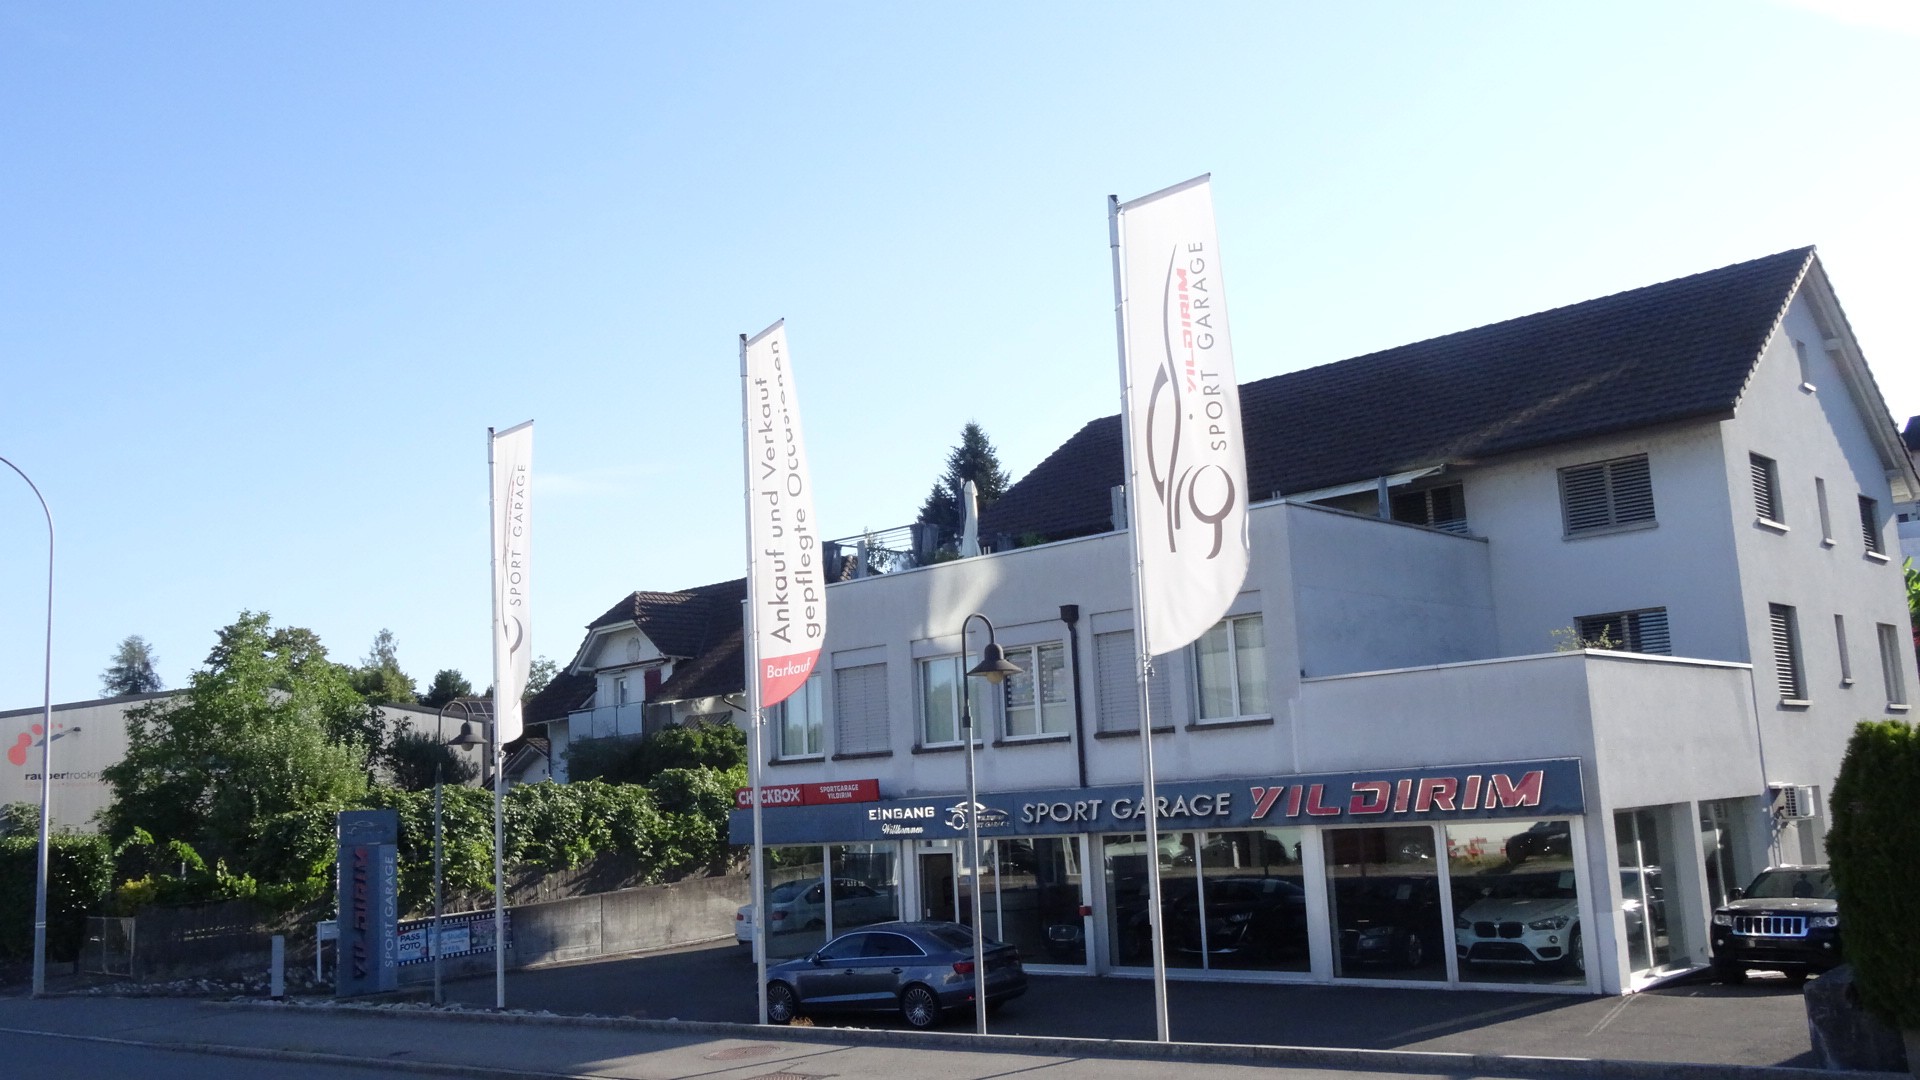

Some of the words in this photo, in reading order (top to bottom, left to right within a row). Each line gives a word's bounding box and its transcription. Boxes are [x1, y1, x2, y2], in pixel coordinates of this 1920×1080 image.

[1188, 242, 1214, 350] GARAGE
[1176, 268, 1197, 394] YILDIRIM
[755, 377, 777, 480] Verkauf
[770, 340, 803, 497] Occasionen
[1201, 369, 1227, 451] SPORT
[512, 464, 526, 538] GARAGE
[762, 490, 784, 538] und
[509, 550, 522, 607] SPORT
[765, 549, 792, 644] Ankauf
[794, 508, 821, 638] gepflegte
[766, 657, 812, 679] Barkauf
[738, 787, 801, 805] CHCKBOX
[819, 783, 859, 793] SPORTGARAGE
[1020, 799, 1103, 824] SPORT
[1110, 792, 1231, 820] GARAGE
[1249, 769, 1545, 820] YILDIRIM
[384, 856, 394, 918] GARAGE
[384, 923, 394, 968] SPORT
[400, 932, 421, 943] PASS
[400, 941, 421, 952] FOTO
